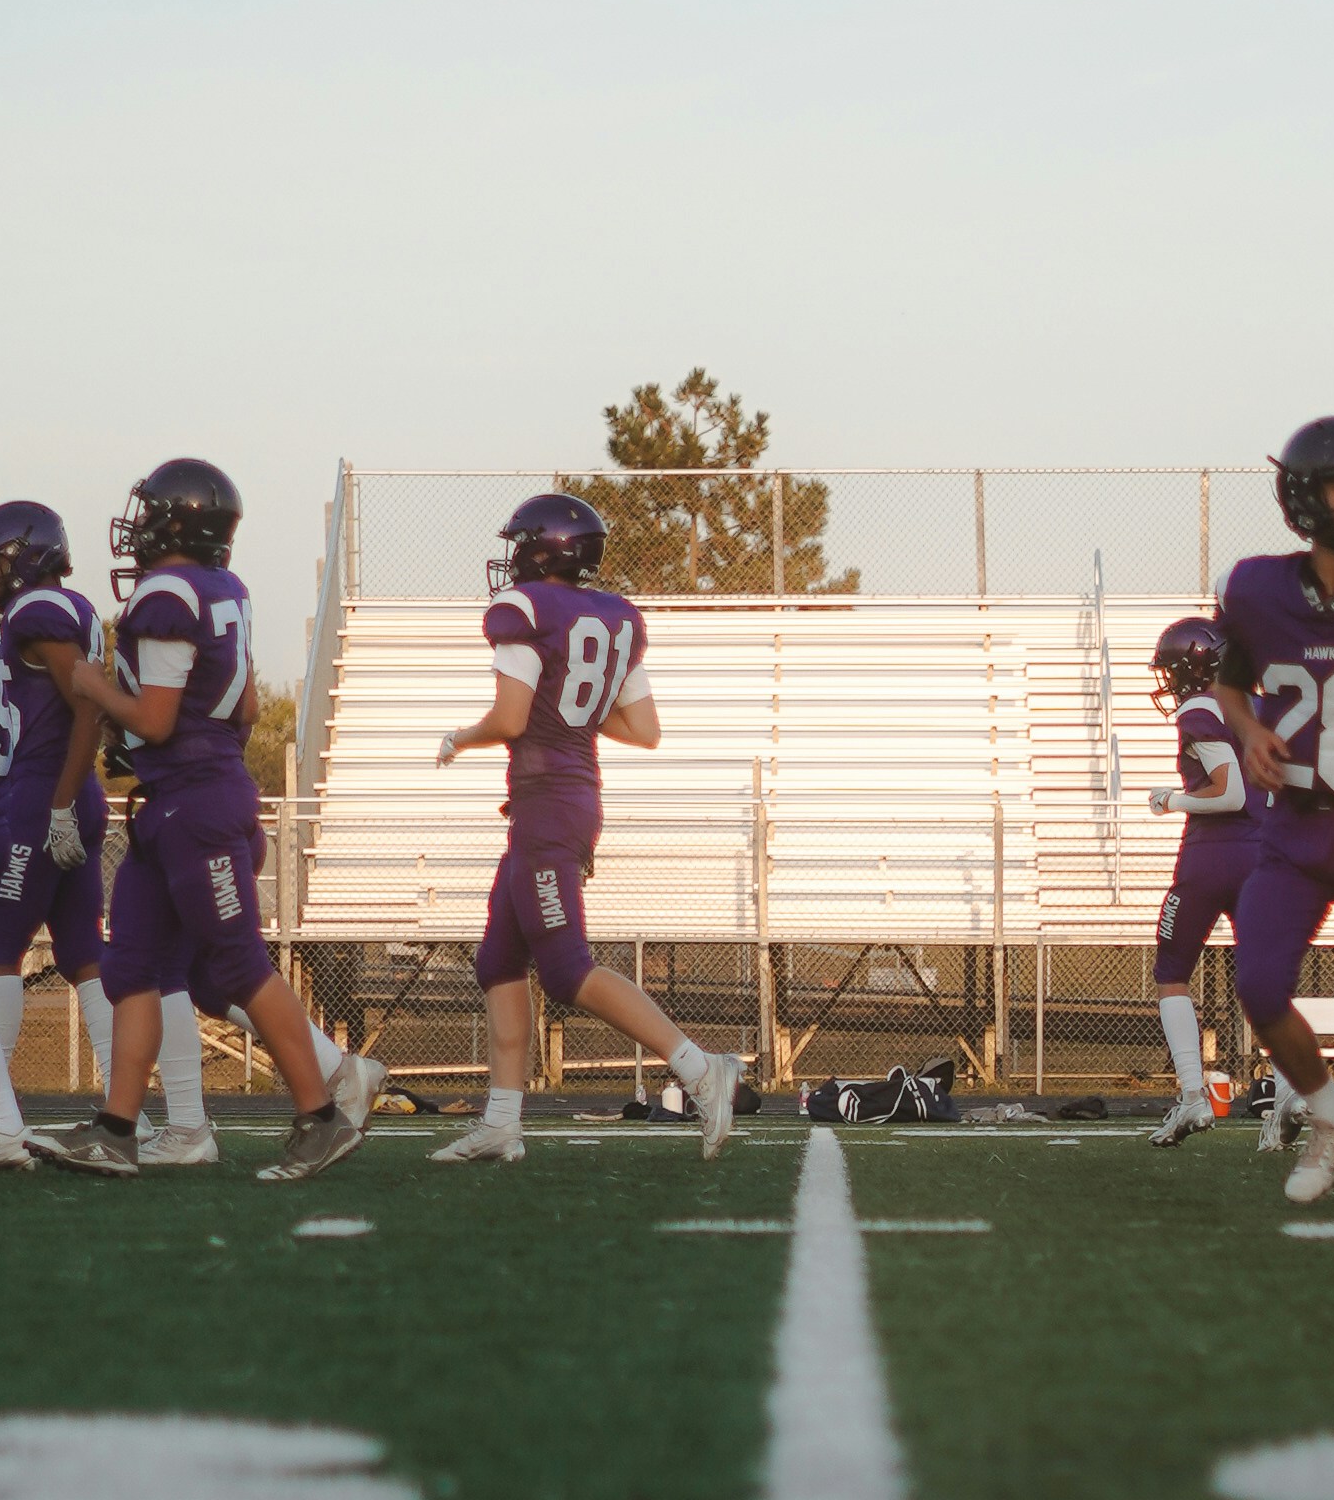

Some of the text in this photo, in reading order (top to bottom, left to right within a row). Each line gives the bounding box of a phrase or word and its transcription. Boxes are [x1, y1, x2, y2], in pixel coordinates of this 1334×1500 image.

[558, 616, 633, 728] 81
[209, 856, 243, 921] HAWKS
[536, 870, 567, 929] HAWKS
[1159, 893, 1181, 940] HAWKS
